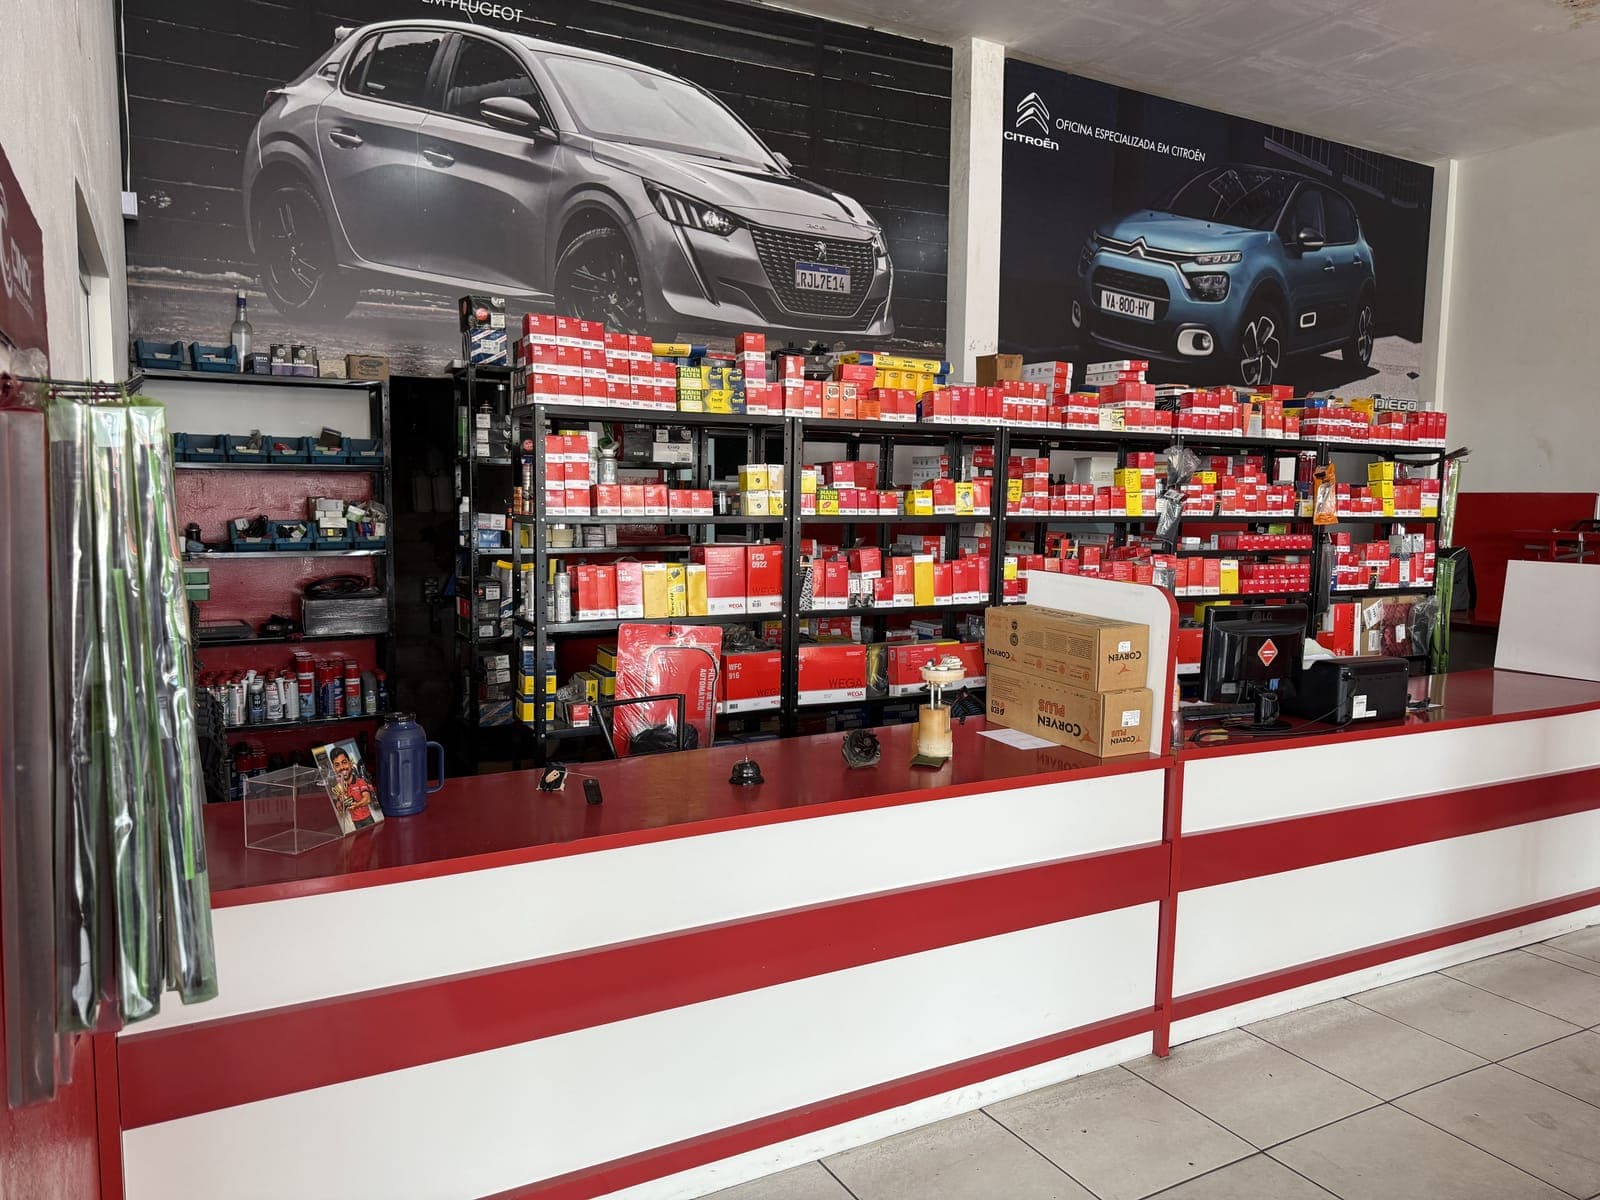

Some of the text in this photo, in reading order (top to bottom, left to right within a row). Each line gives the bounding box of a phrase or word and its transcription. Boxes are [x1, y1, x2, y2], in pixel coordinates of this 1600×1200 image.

[1055, 118, 1206, 163] OFICINA ESPECIALIZADA EM CITROËN
[800, 272, 845, 292] RJL7E14
[987, 647, 1010, 659] CORVEN
[1108, 651, 1141, 663] CORVEN
[728, 663, 742, 671] WFC
[828, 678, 864, 689] WEGA
[1038, 699, 1065, 718] PLUS
[1037, 714, 1082, 737] CORVEN
[1111, 729, 1127, 737] PLUS
[1110, 735, 1136, 746] CORVEN
